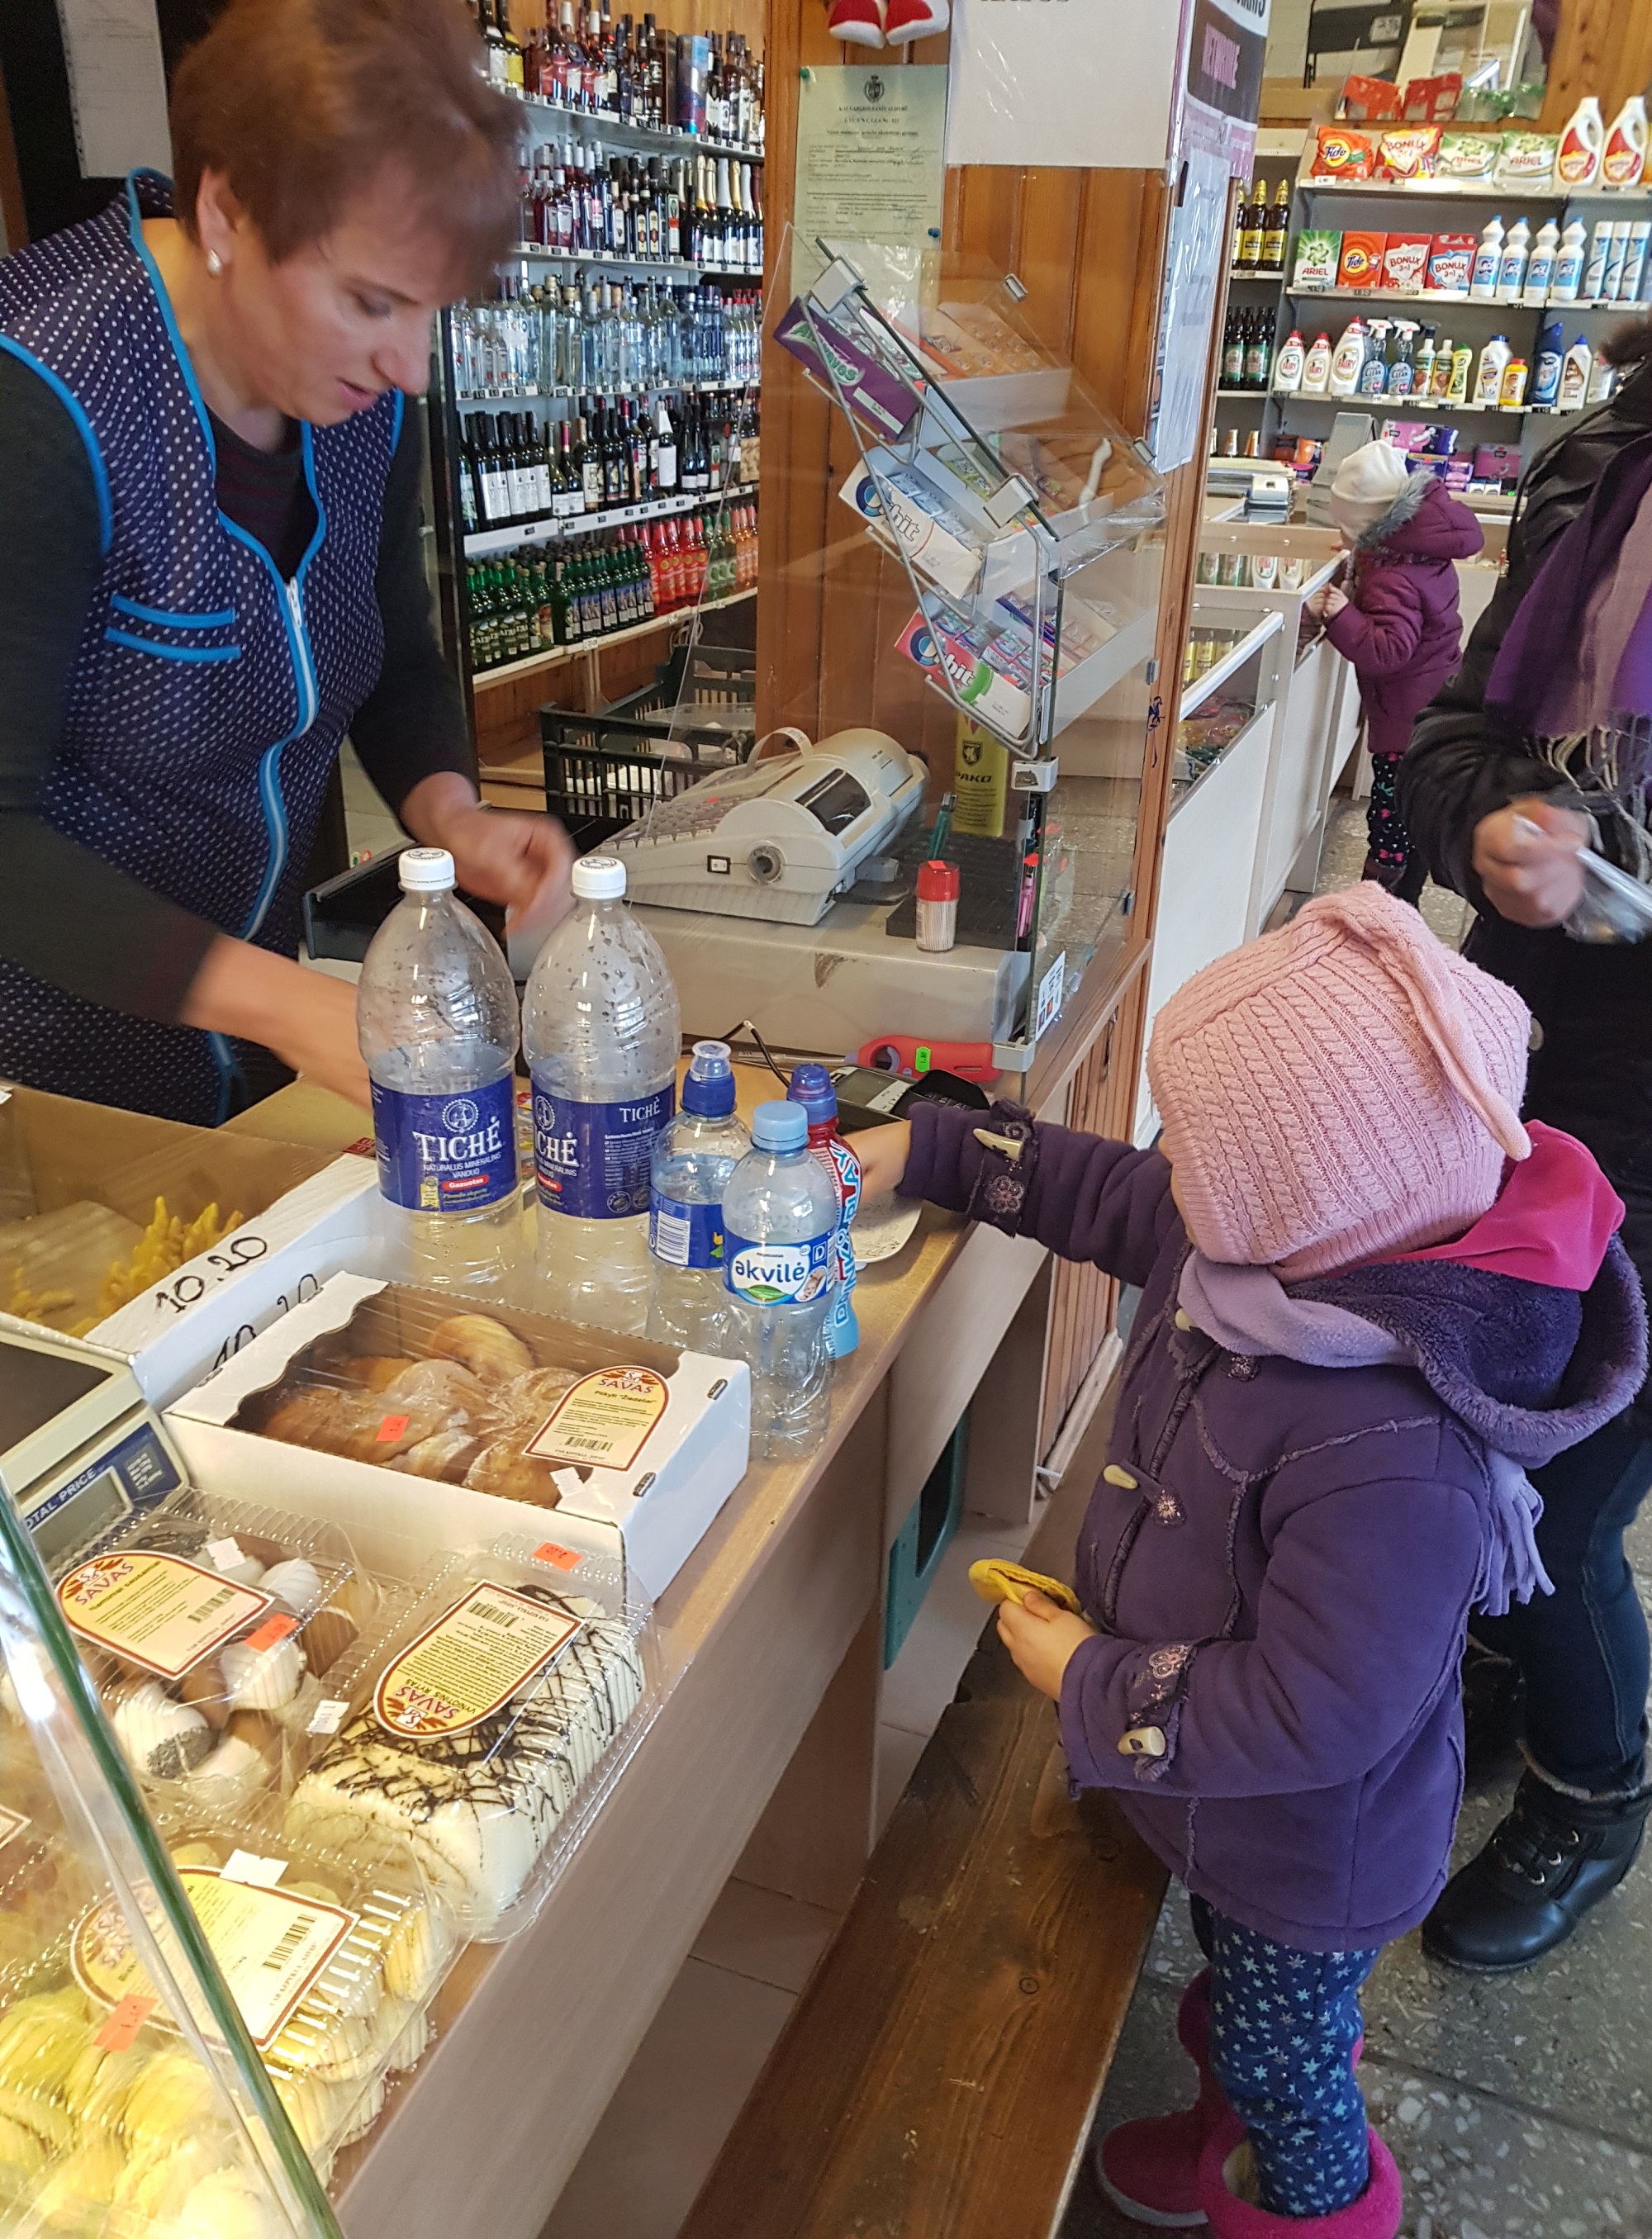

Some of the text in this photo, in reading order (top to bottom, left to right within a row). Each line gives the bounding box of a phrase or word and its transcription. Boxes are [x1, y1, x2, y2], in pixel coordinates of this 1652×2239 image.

[1346, 255, 1365, 268] Tide
[1390, 256, 1422, 268] BONUX
[1435, 262, 1466, 272] BONUX
[1302, 267, 1329, 276] ARIEL
[1283, 361, 1296, 370] FAIRY
[1309, 365, 1322, 374] FAIRY
[1337, 357, 1355, 371] FAIRY
[620, 1097, 661, 1122] TICHĖ
[412, 1116, 503, 1162] TICHĖ
[535, 1132, 580, 1167] CHĖ
[464, 1152, 502, 1169] MINERALINIS
[453, 1169, 480, 1179] VANDUO
[449, 1178, 484, 1188] Gazuotas
[155, 1236, 268, 1313] 10.20
[735, 1259, 805, 1283] akvilė
[598, 1378, 653, 1393] SAVAS
[24, 1503, 58, 1529] OTAL
[59, 1468, 97, 1501] PRICE
[75, 1562, 135, 1606] SAVAS
[405, 1677, 434, 1697] RYTAS
[395, 1685, 463, 1720] SAVAS
